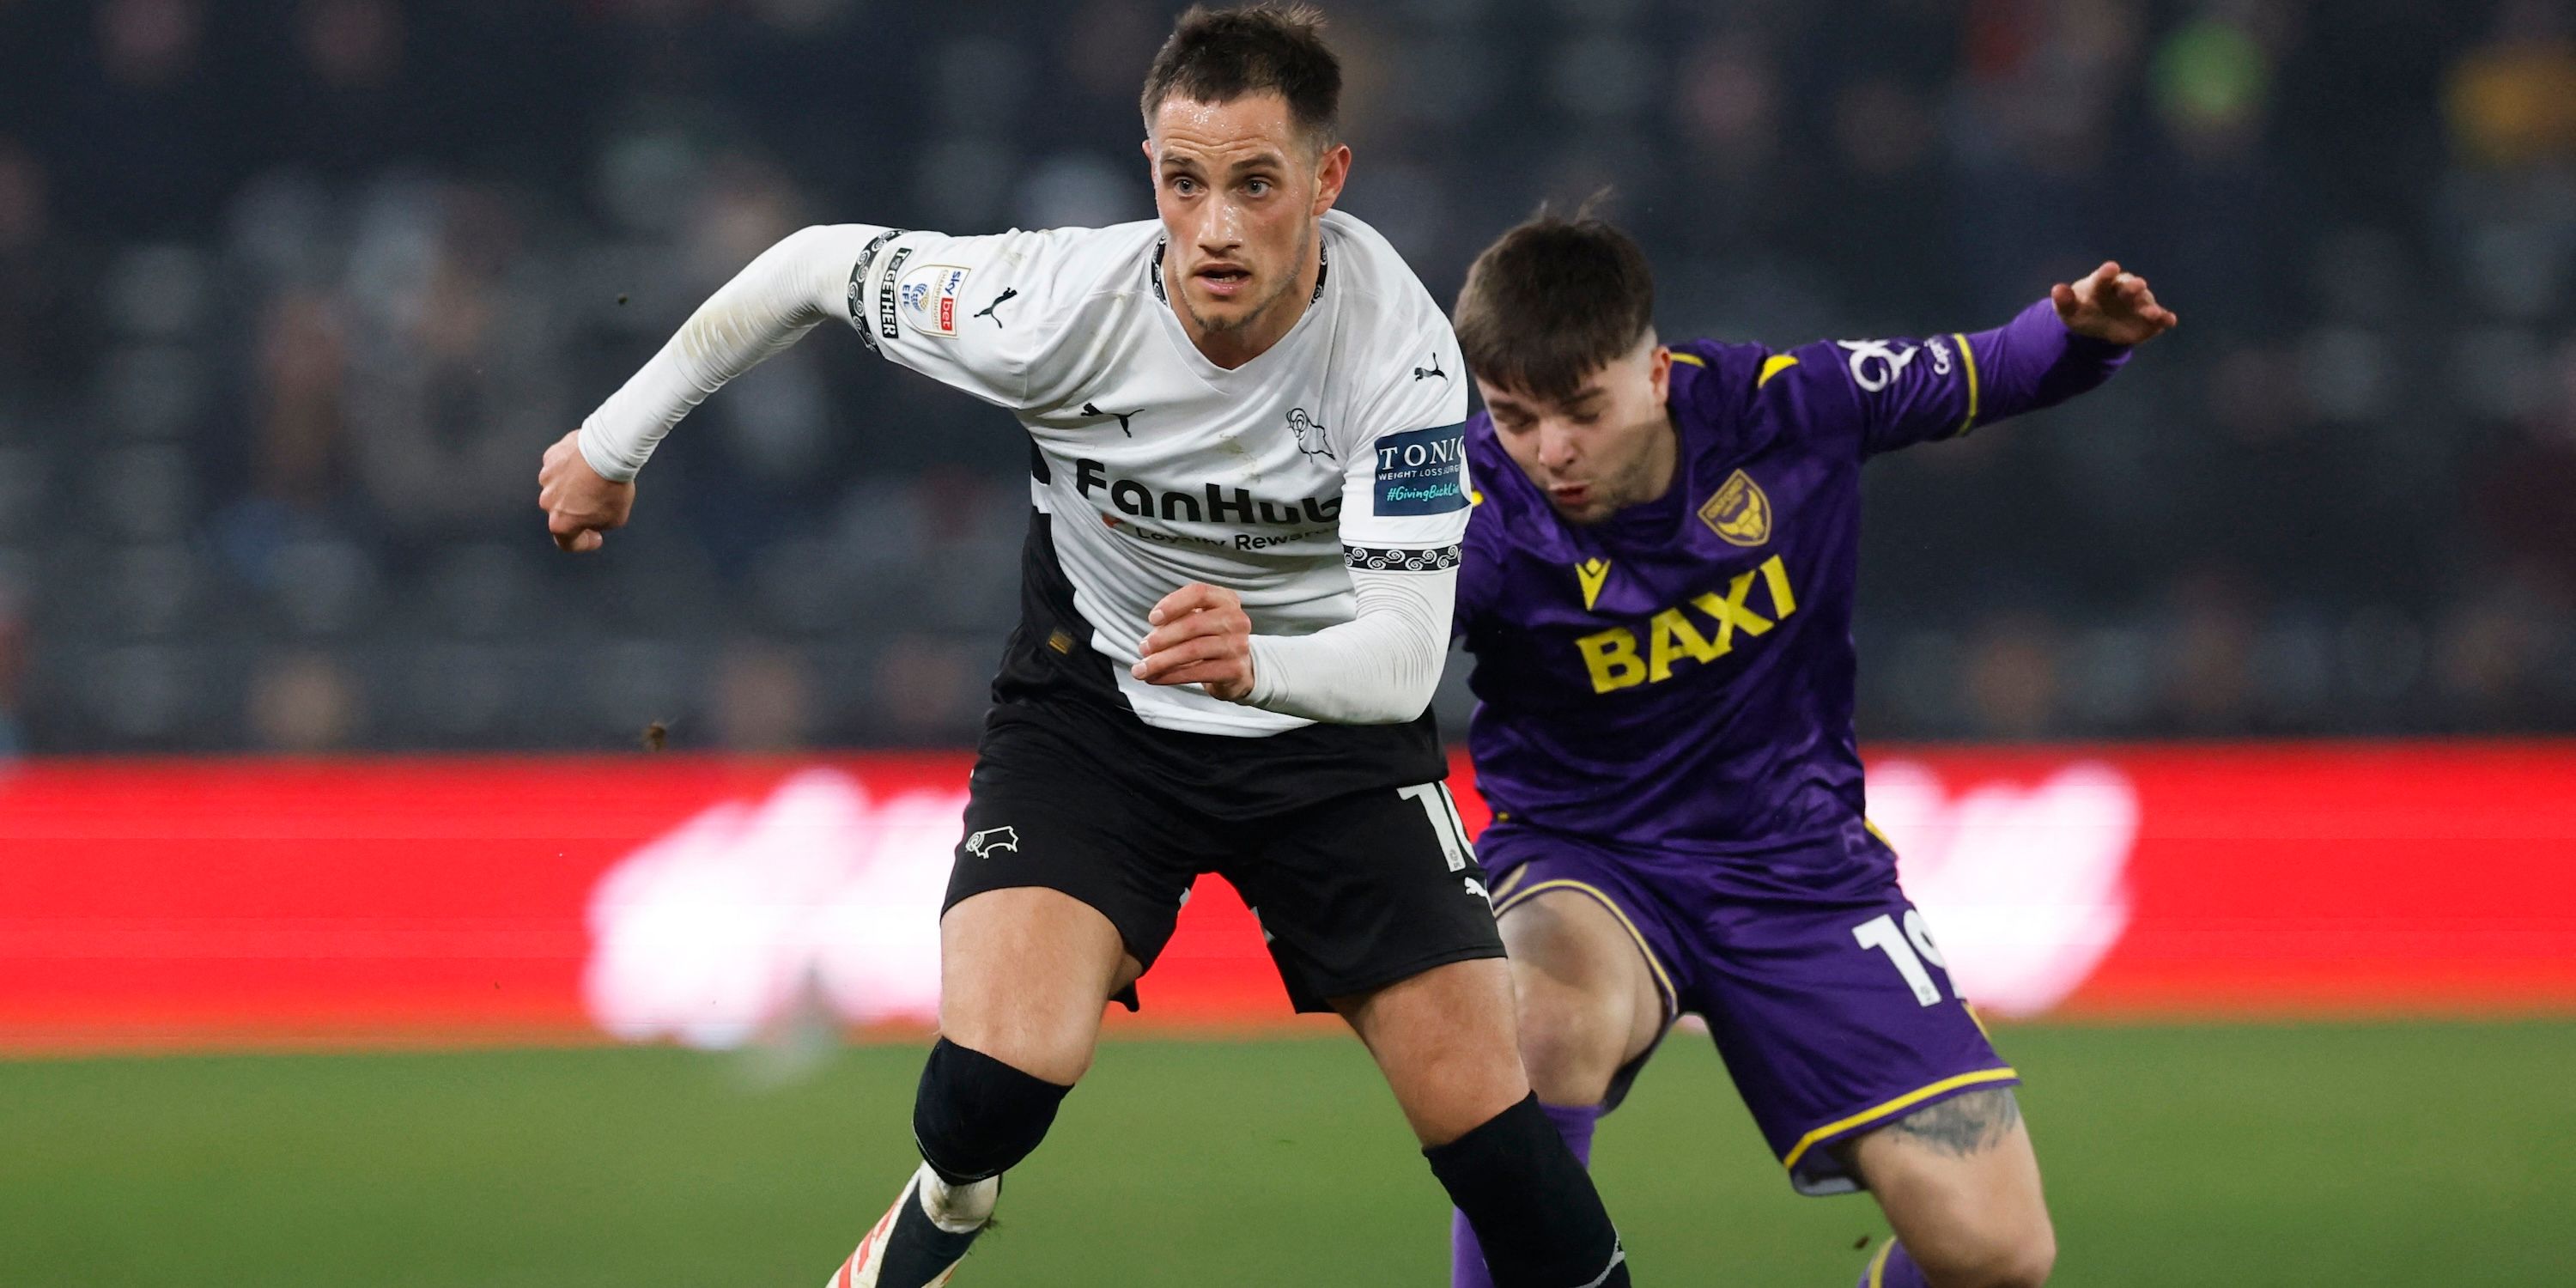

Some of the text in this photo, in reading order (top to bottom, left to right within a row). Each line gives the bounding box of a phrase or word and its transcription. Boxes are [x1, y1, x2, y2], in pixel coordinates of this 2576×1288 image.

[882, 250, 910, 335] TOGETHER
[902, 284, 911, 307] EFL
[943, 270, 961, 329] sky bet
[1076, 459, 1341, 524] FanHub
[1378, 470, 1418, 481] WEIGHT
[1419, 468, 1443, 477] LOSS
[1575, 554, 1797, 694] BAXI
